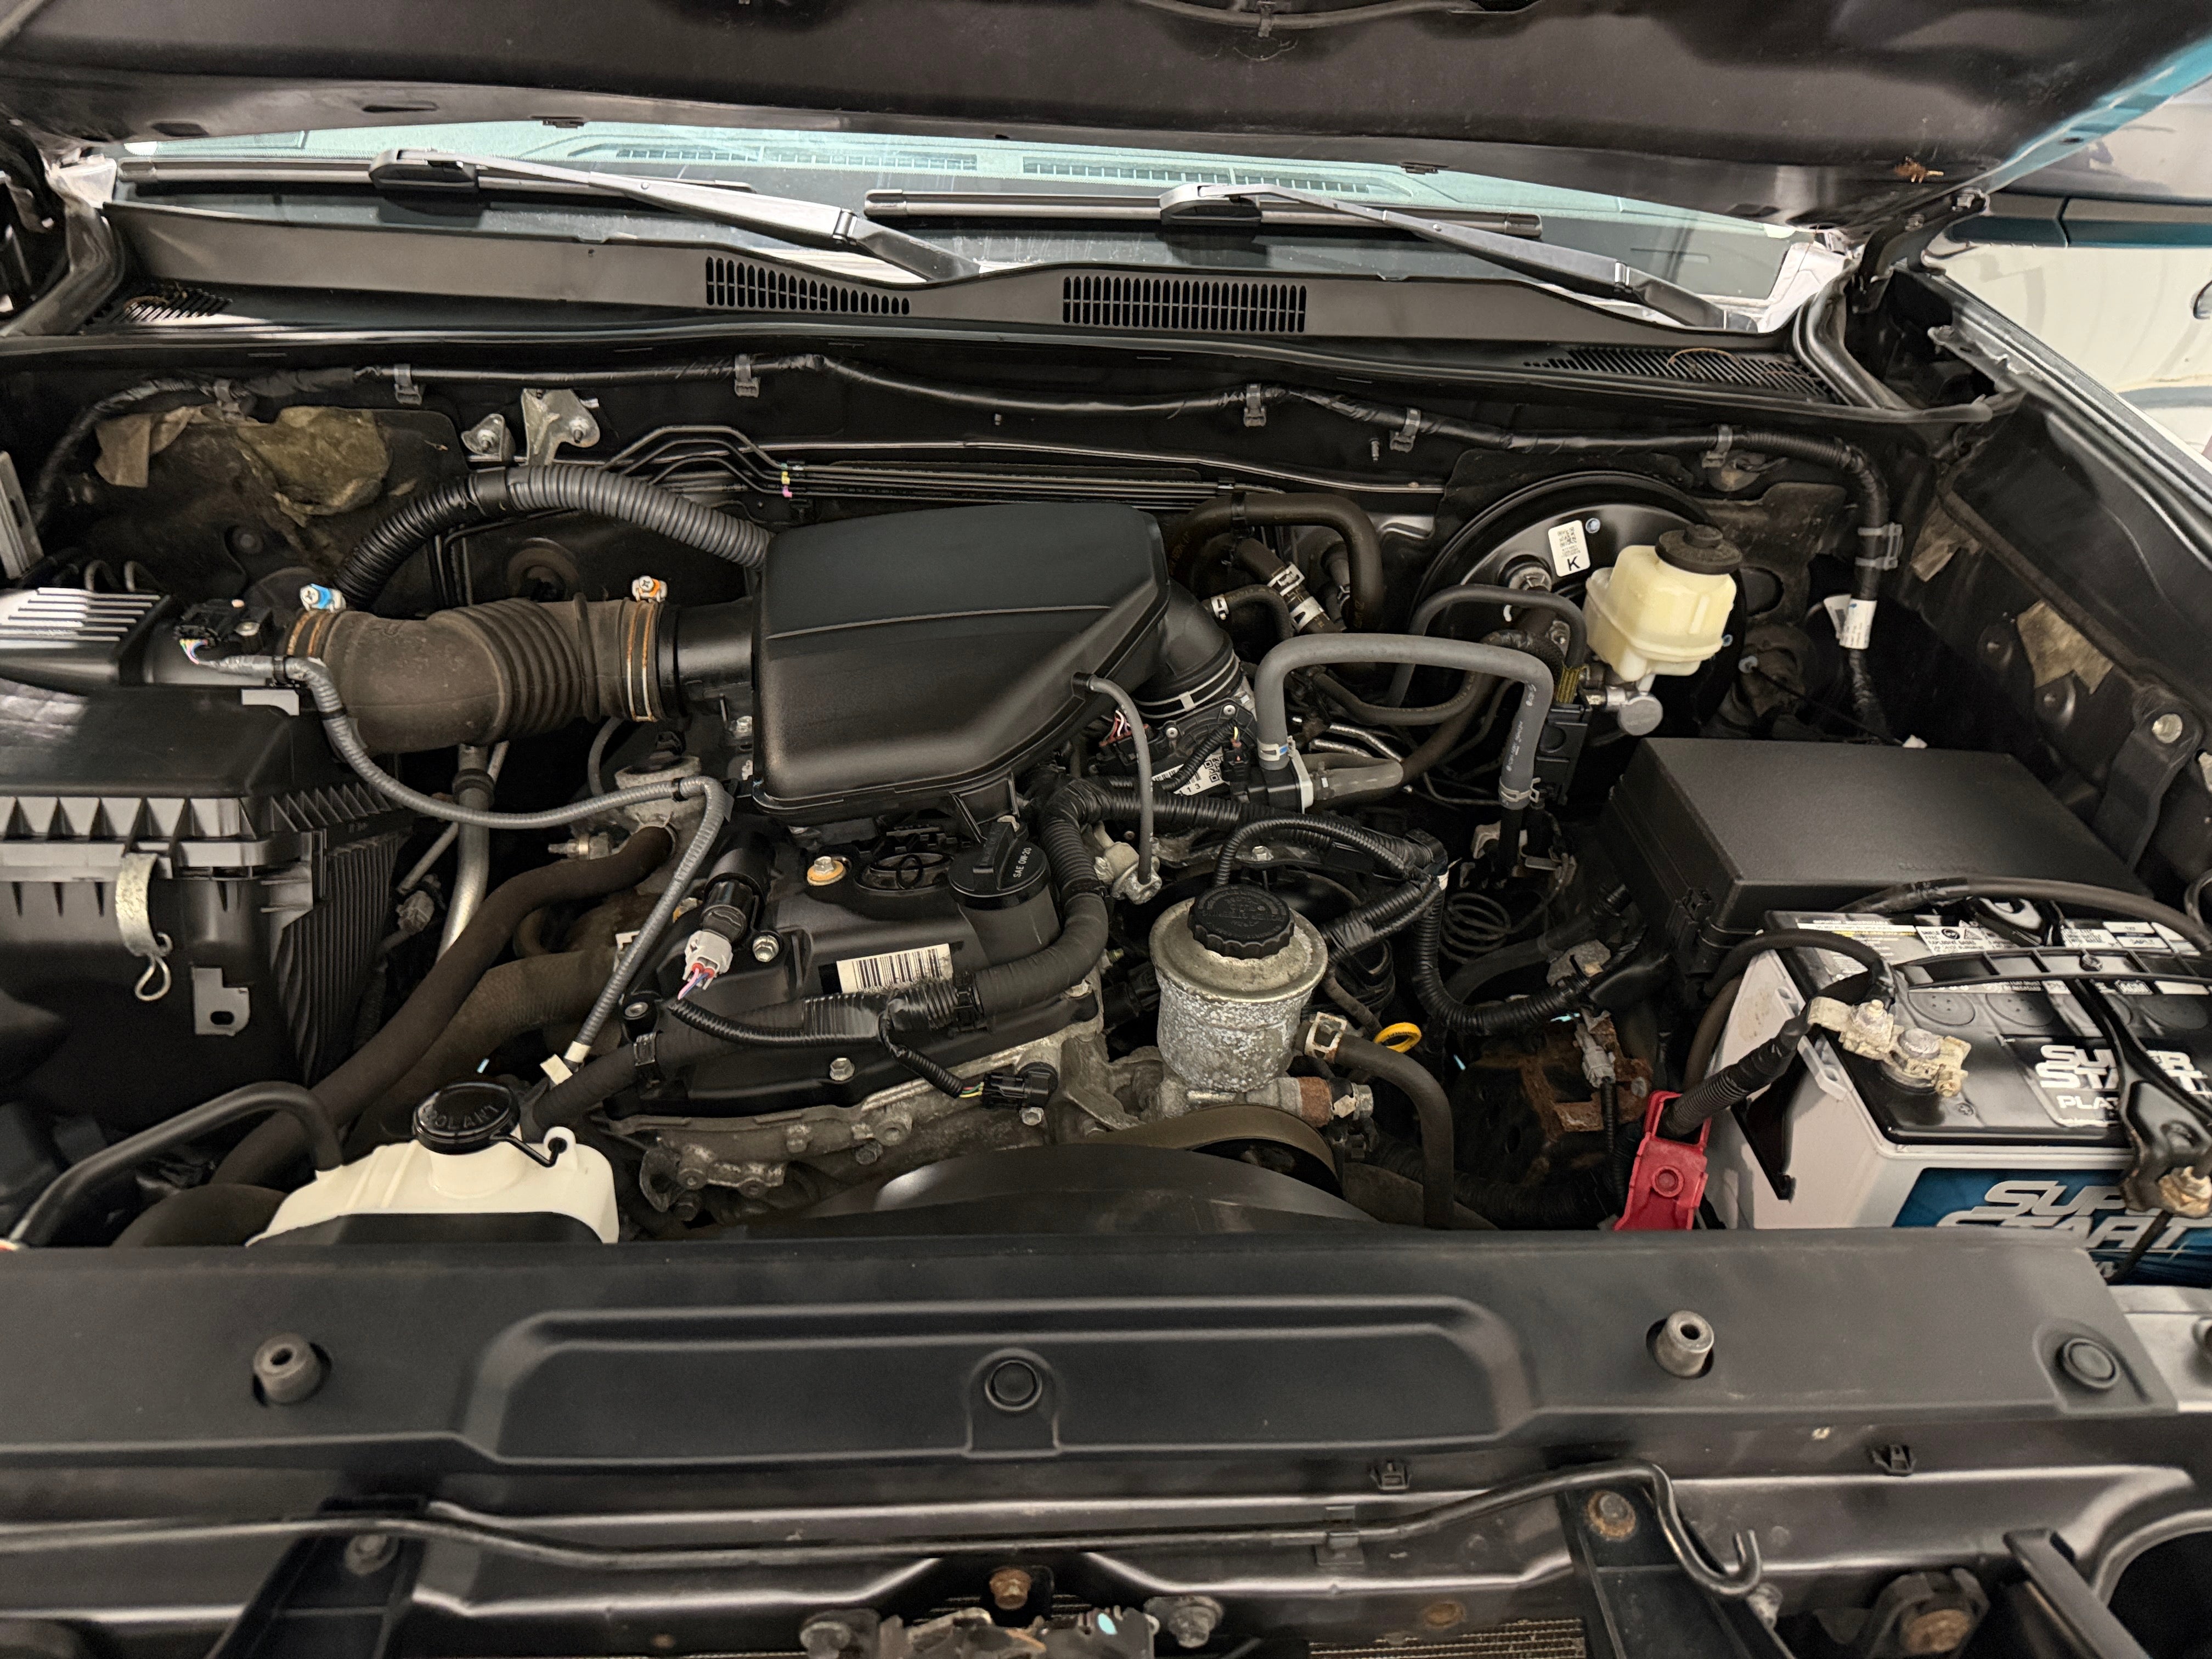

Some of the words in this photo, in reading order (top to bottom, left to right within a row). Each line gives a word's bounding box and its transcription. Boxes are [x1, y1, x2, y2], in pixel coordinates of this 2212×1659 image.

[1567, 555, 1581, 571] K
[1018, 847, 1032, 865] 0W-20
[1013, 865, 1024, 878] SAE
